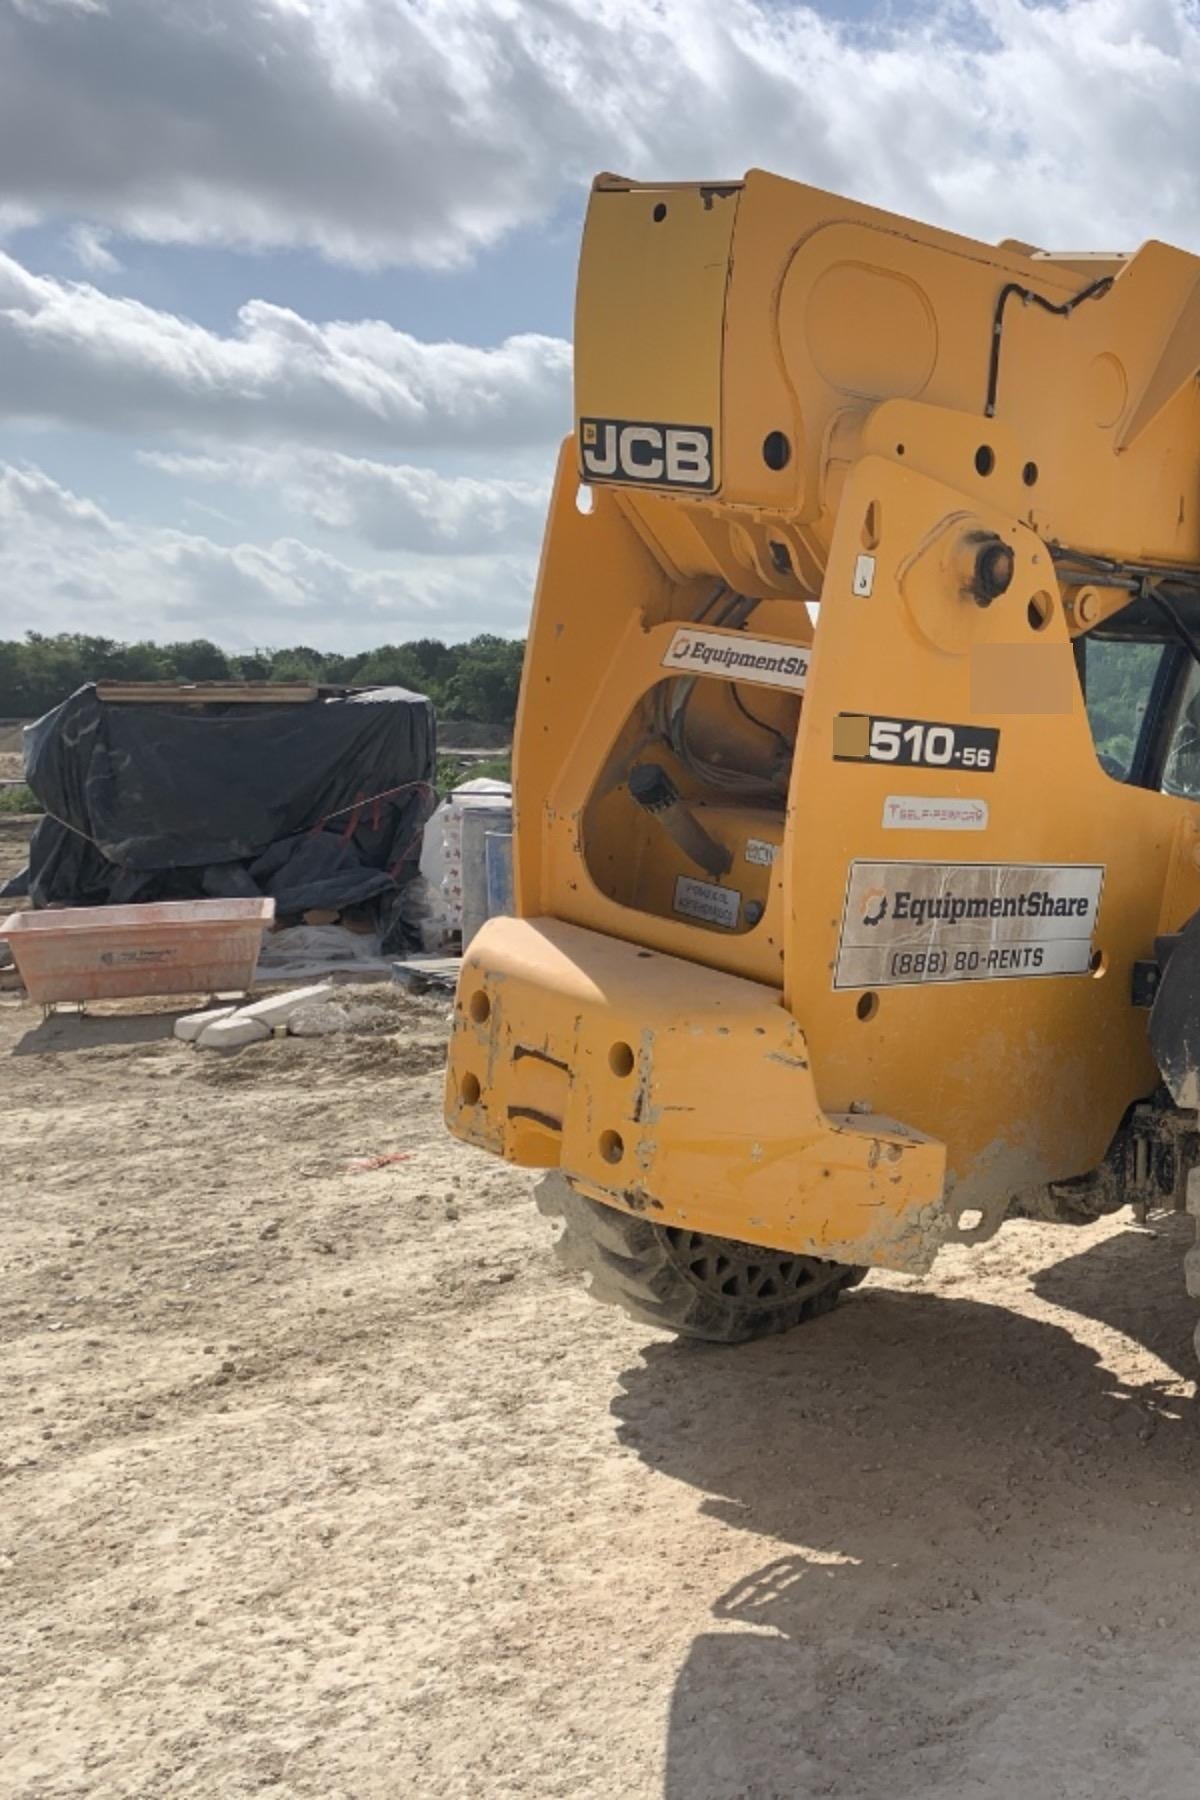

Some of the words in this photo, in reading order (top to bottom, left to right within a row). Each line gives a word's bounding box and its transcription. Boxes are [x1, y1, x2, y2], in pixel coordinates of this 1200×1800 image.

[583, 425, 711, 483] JCB
[891, 891, 1090, 925] EquipmentShare
[890, 951, 948, 977] (888)
[953, 947, 1044, 971] 80-RENTS
